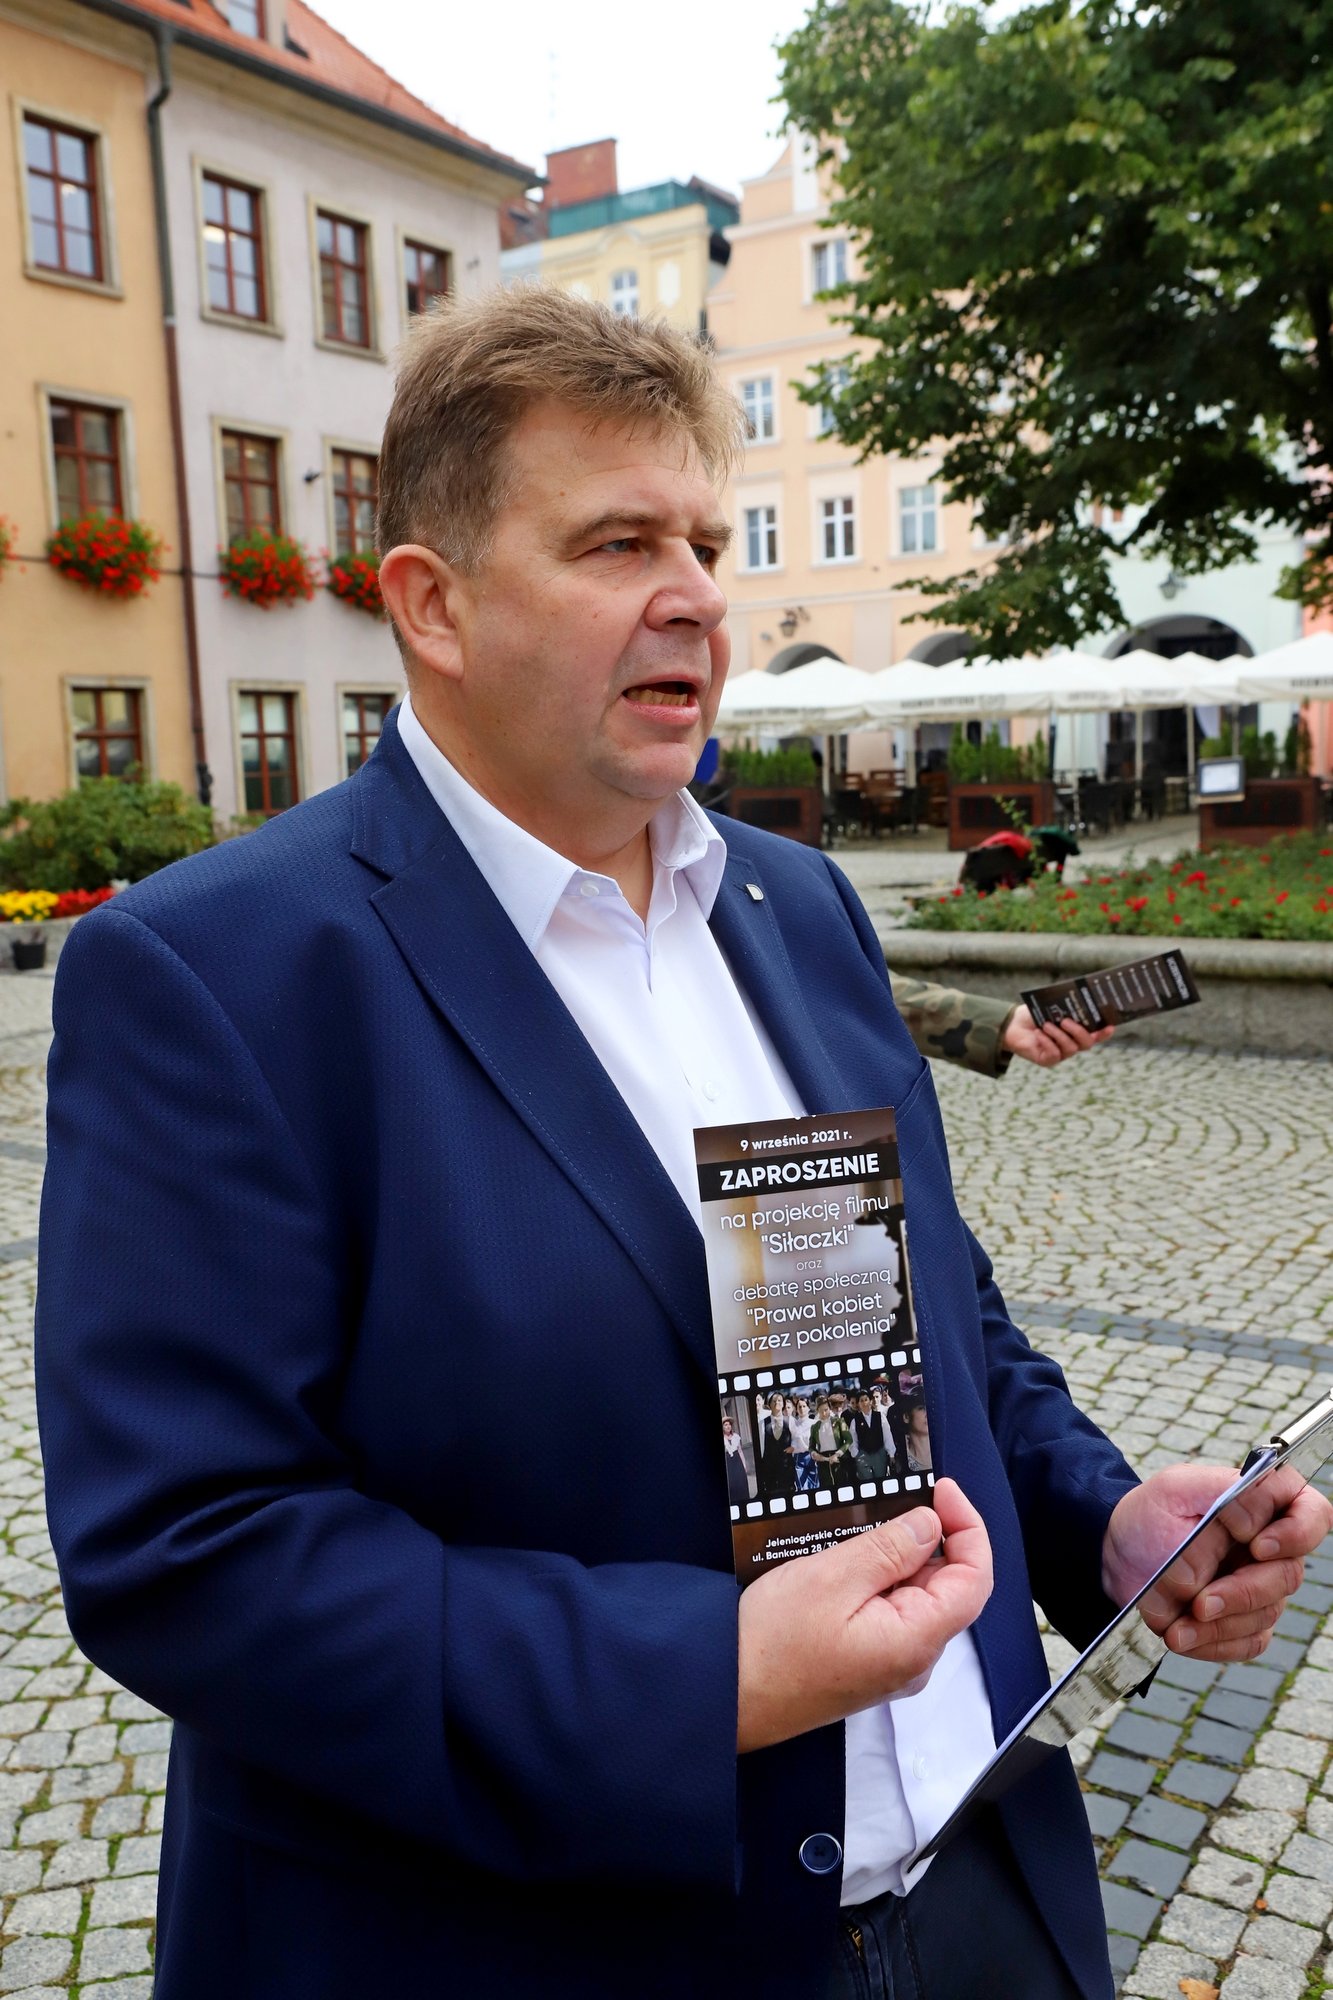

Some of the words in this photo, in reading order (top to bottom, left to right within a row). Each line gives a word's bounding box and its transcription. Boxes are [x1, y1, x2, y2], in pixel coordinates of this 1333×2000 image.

[740, 1139, 749, 1151] 9
[752, 1134, 809, 1150] września
[811, 1129, 840, 1143] 2021
[843, 1130, 852, 1141] r.
[720, 1152, 880, 1191] ZAPROSZENIE
[720, 1213, 746, 1230] na
[752, 1200, 840, 1230] projekcję
[845, 1195, 889, 1213] filmu
[761, 1224, 855, 1254] "Siłaczki"
[796, 1259, 823, 1271] oraz
[733, 1281, 799, 1302] debatę
[803, 1269, 891, 1292] społeczną
[747, 1303, 816, 1326] "Prawa
[822, 1292, 883, 1319] kobiet
[737, 1332, 791, 1358] przez
[796, 1313, 896, 1349] pokolenia"
[765, 1530, 833, 1548] Jeleniogórskie
[834, 1525, 874, 1537] Centrum
[752, 1553, 764, 1562] ul.
[766, 1548, 809, 1560] Bankowa
